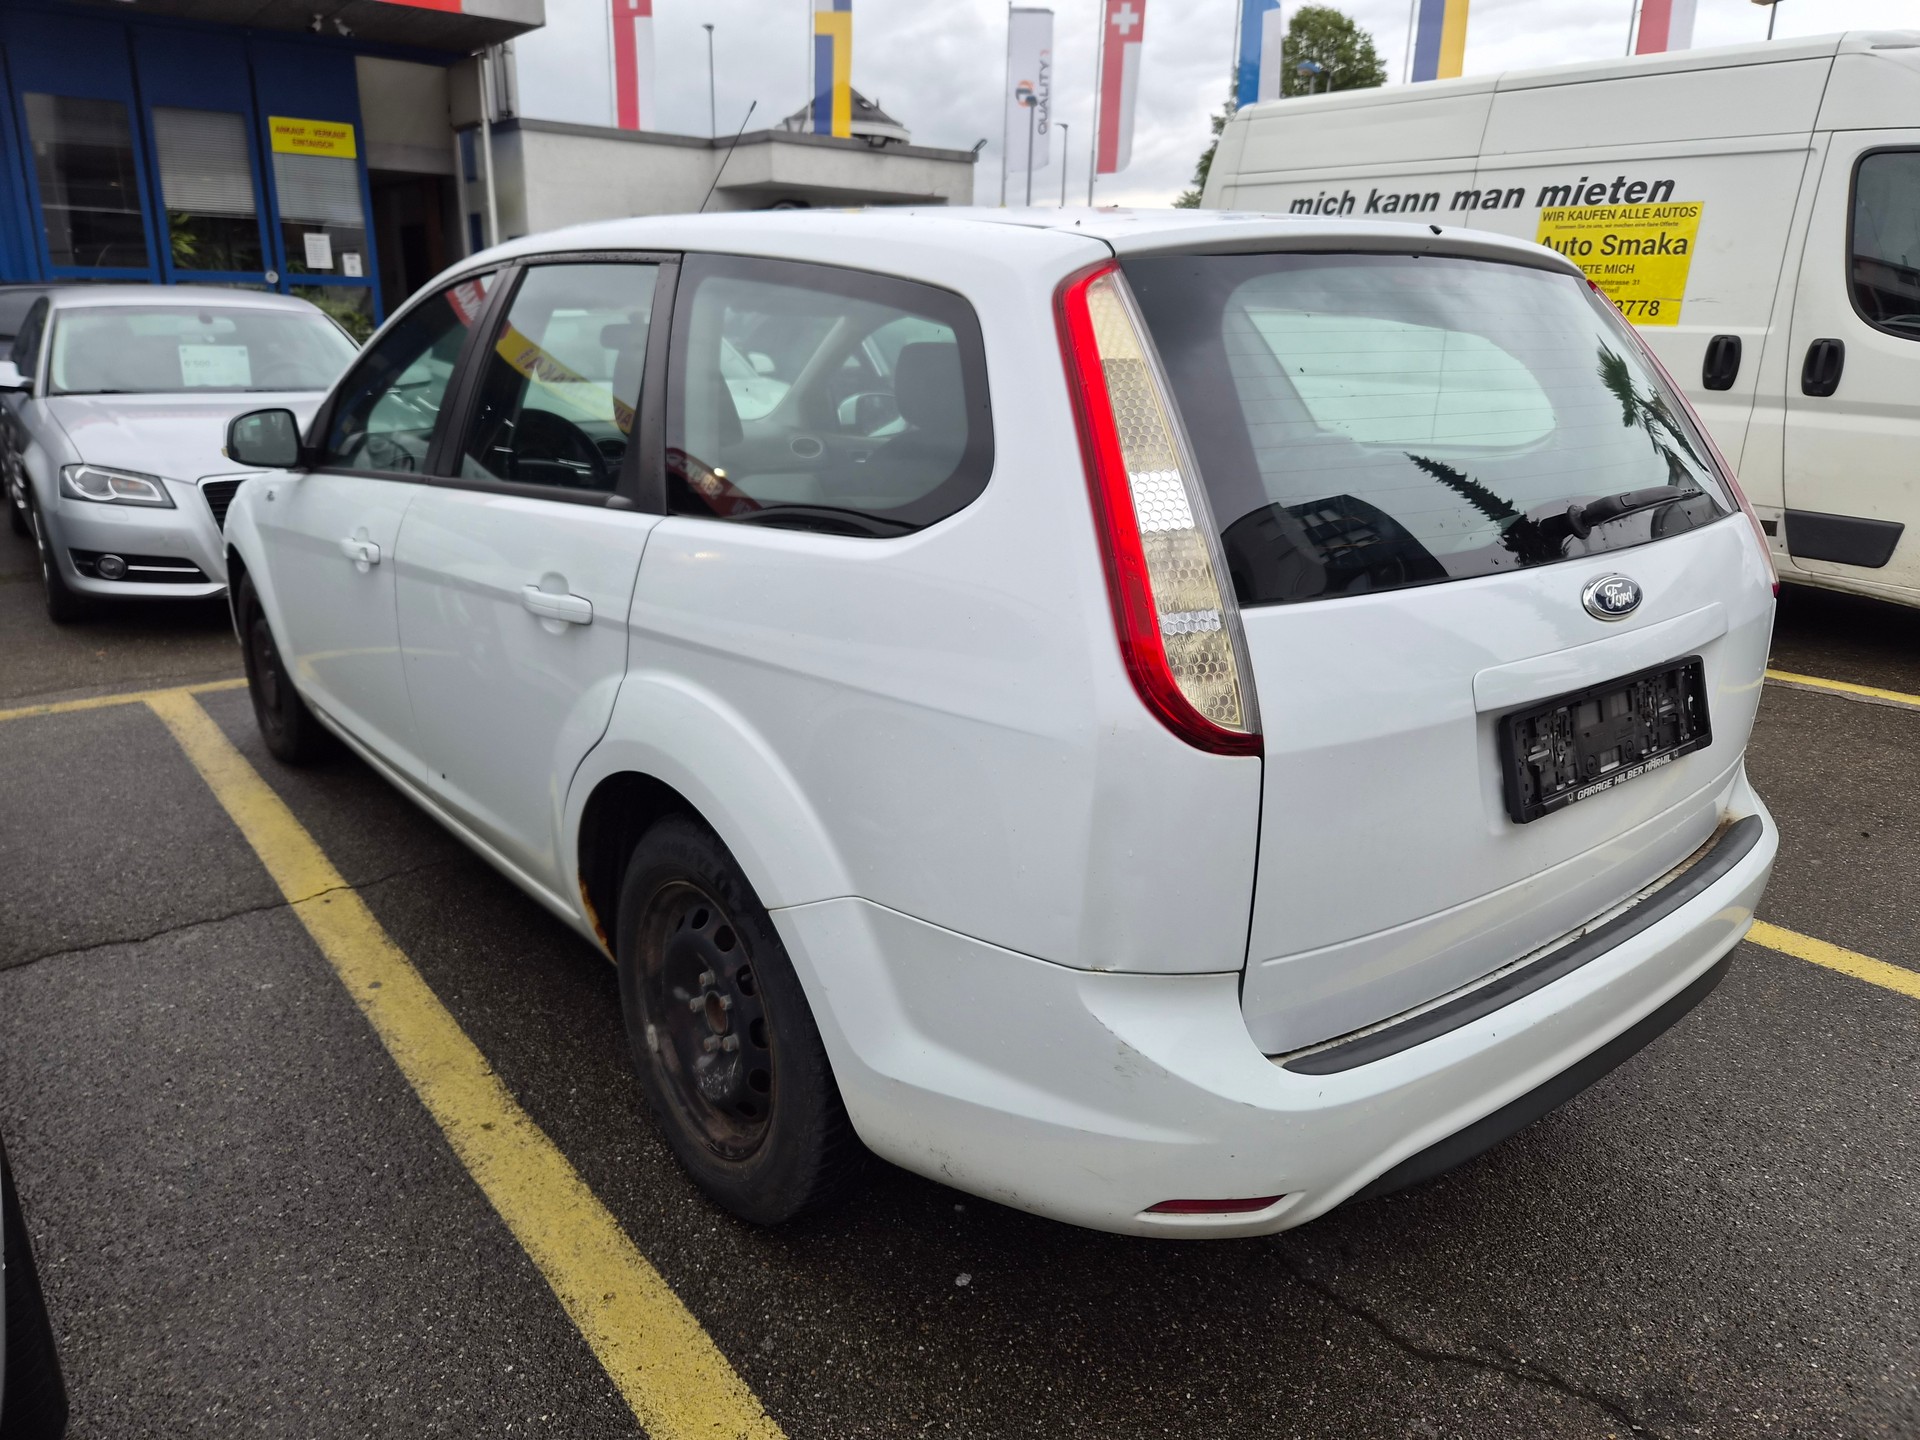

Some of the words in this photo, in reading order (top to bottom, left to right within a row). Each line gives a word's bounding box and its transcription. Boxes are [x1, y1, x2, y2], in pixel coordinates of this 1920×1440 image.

[1037, 60, 1049, 135] QUALITY
[1288, 190, 1356, 216] mich
[1363, 188, 1440, 214] kann
[1449, 187, 1526, 212] man
[1535, 176, 1675, 207] mieten
[1542, 211, 1564, 222] WIR
[1567, 209, 1617, 221] KAUFEN
[1619, 208, 1651, 219] ALLE
[1652, 206, 1698, 218] AUTOS
[1542, 235, 1593, 256] Auto
[1600, 232, 1688, 256] Smaka
[1604, 264, 1635, 275] MICH
[1612, 300, 1660, 317] 3778
[1605, 582, 1635, 609] Ford
[1577, 779, 1613, 800] GARAGE
[1615, 766, 1644, 785] HILBER
